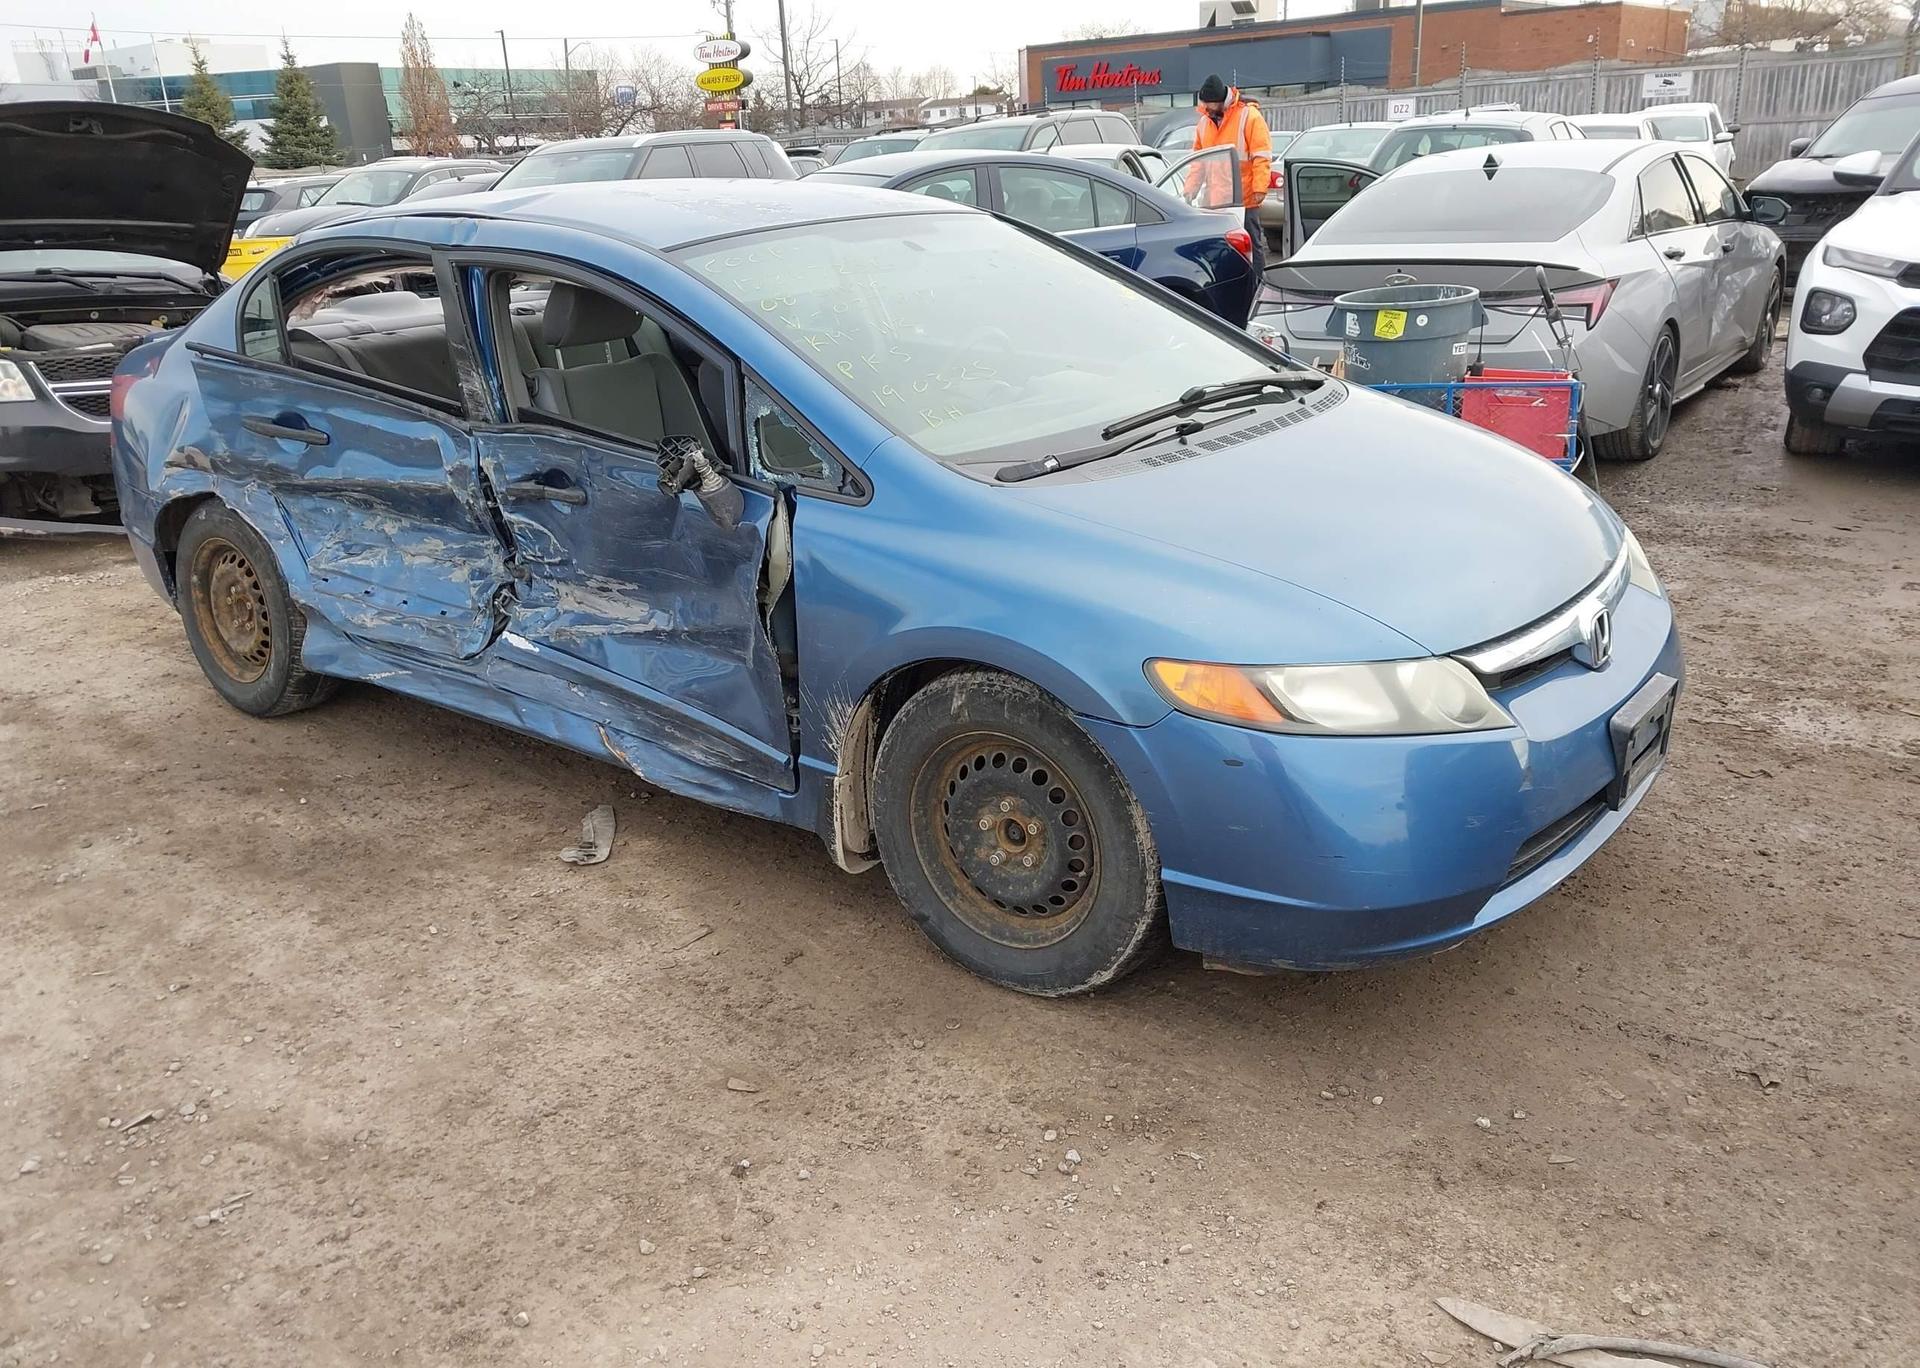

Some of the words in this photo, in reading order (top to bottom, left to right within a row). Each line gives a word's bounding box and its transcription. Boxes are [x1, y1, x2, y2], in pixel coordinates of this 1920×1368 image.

[698, 47, 711, 59] Tim
[713, 45, 738, 58] Hortons
[701, 77, 720, 85] ALWAYS
[1056, 64, 1087, 92] Tim
[1089, 62, 1161, 88] Hortons
[707, 103, 722, 111] DRIVE
[723, 101, 738, 110] THRU
[1393, 104, 1410, 114] DZ2
